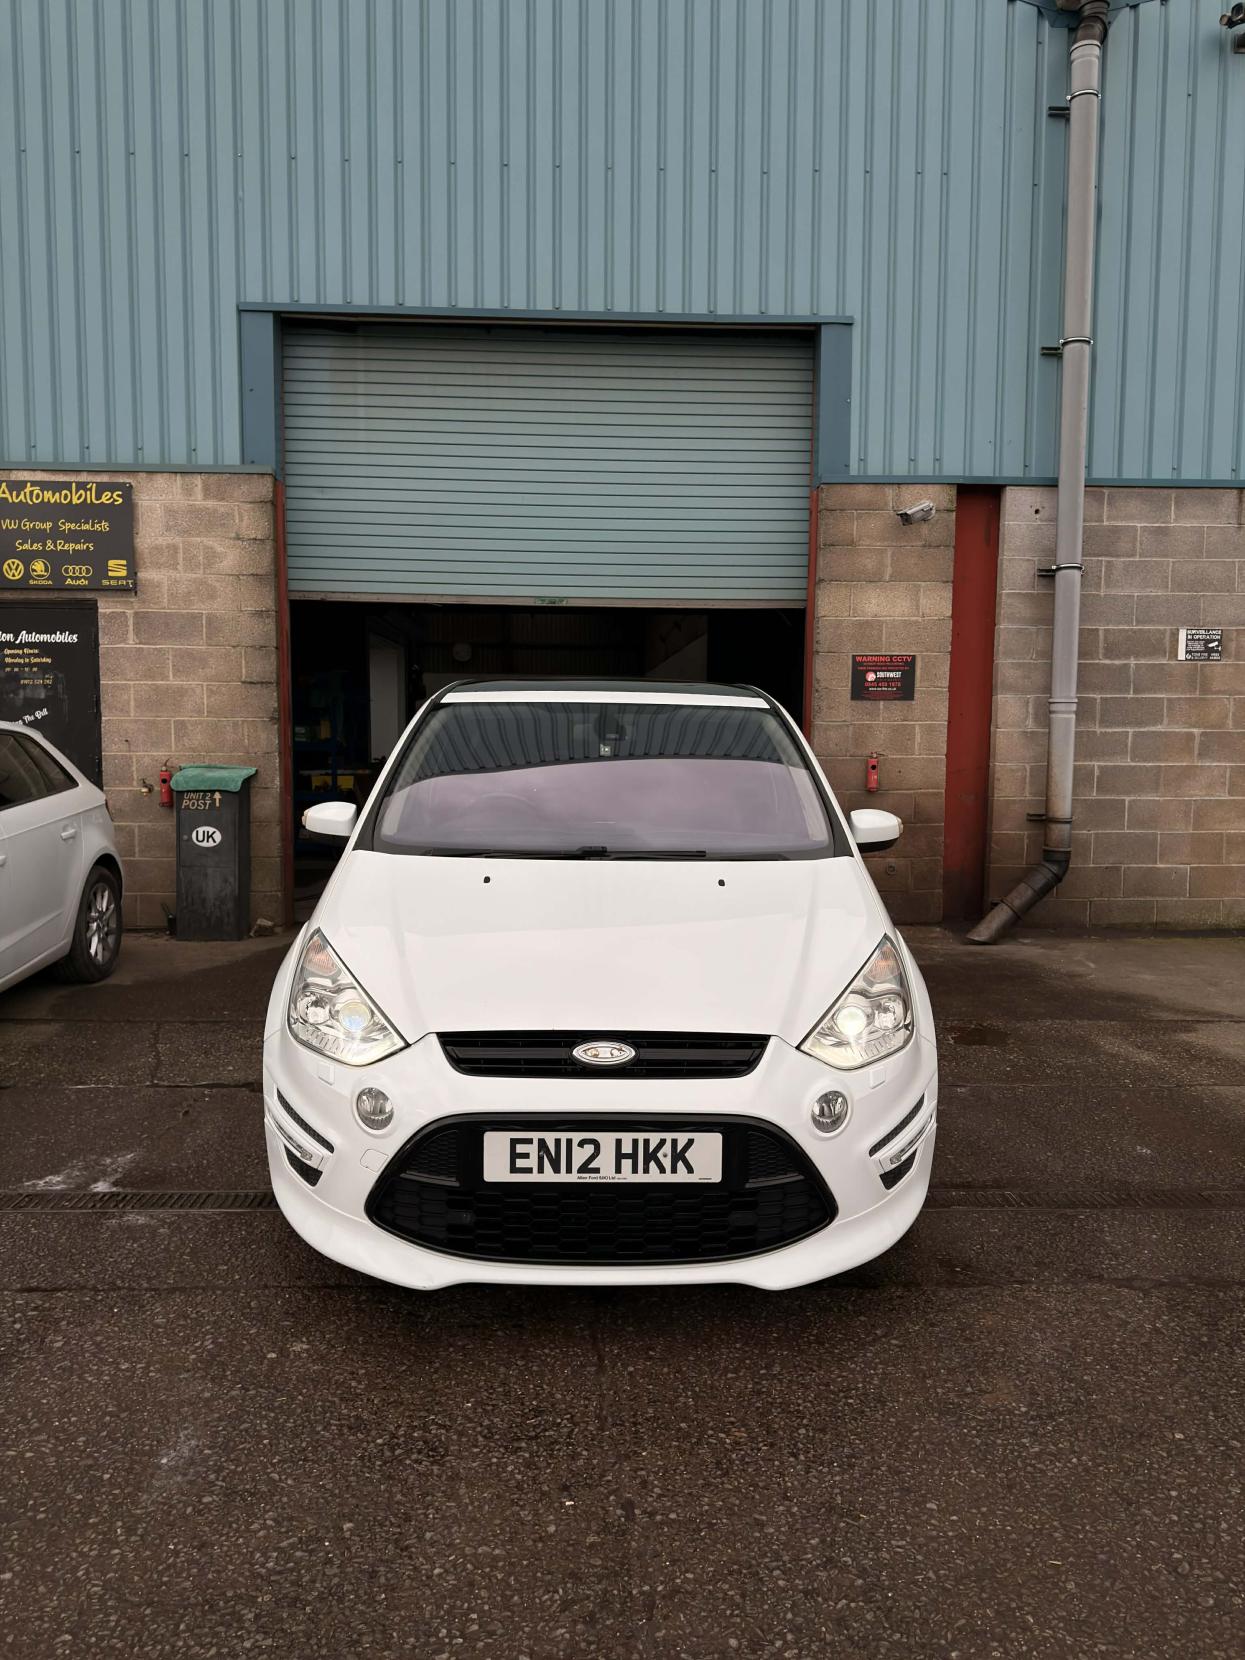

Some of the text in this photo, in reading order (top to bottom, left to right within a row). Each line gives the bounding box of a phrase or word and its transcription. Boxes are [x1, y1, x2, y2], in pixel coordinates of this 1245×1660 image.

[0, 482, 123, 505] Automobiles
[1, 519, 110, 534] VW Group Specialists
[15, 540, 94, 554] Sales & Repairs
[15, 630, 78, 643] Automobiles
[182, 800, 212, 809] POST
[195, 830, 217, 843] UK
[509, 1138, 695, 1174] EN12 HKK
